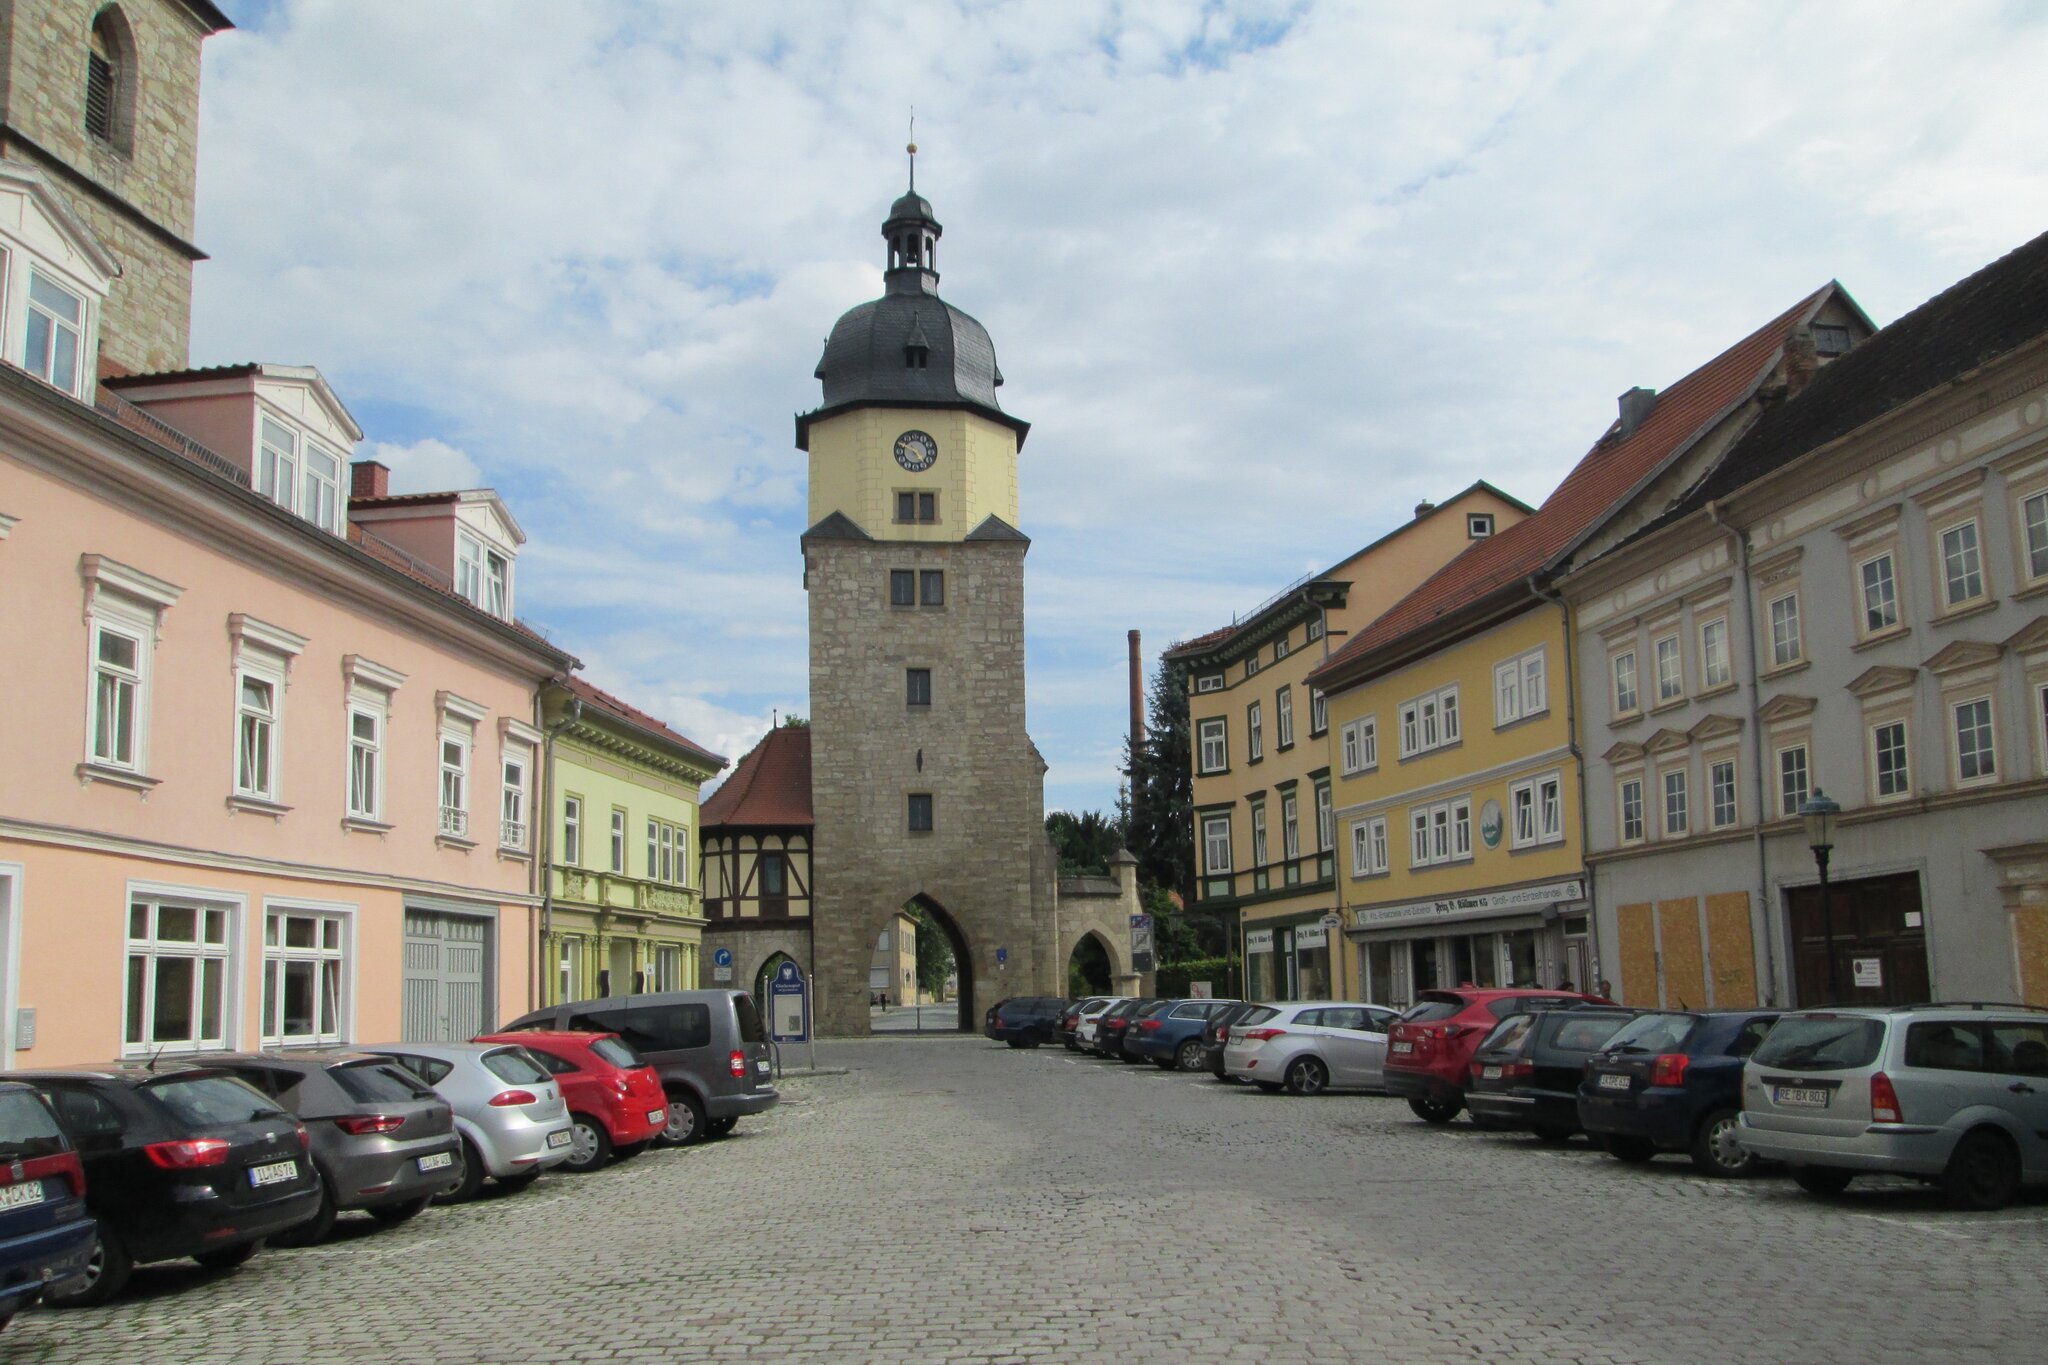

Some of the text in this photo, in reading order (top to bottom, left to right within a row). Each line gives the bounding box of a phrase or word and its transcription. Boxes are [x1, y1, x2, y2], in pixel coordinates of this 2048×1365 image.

[1479, 898, 1488, 907] KG
[1510, 894, 1521, 903] und
[1779, 1088, 1826, 1103] RE BX 803
